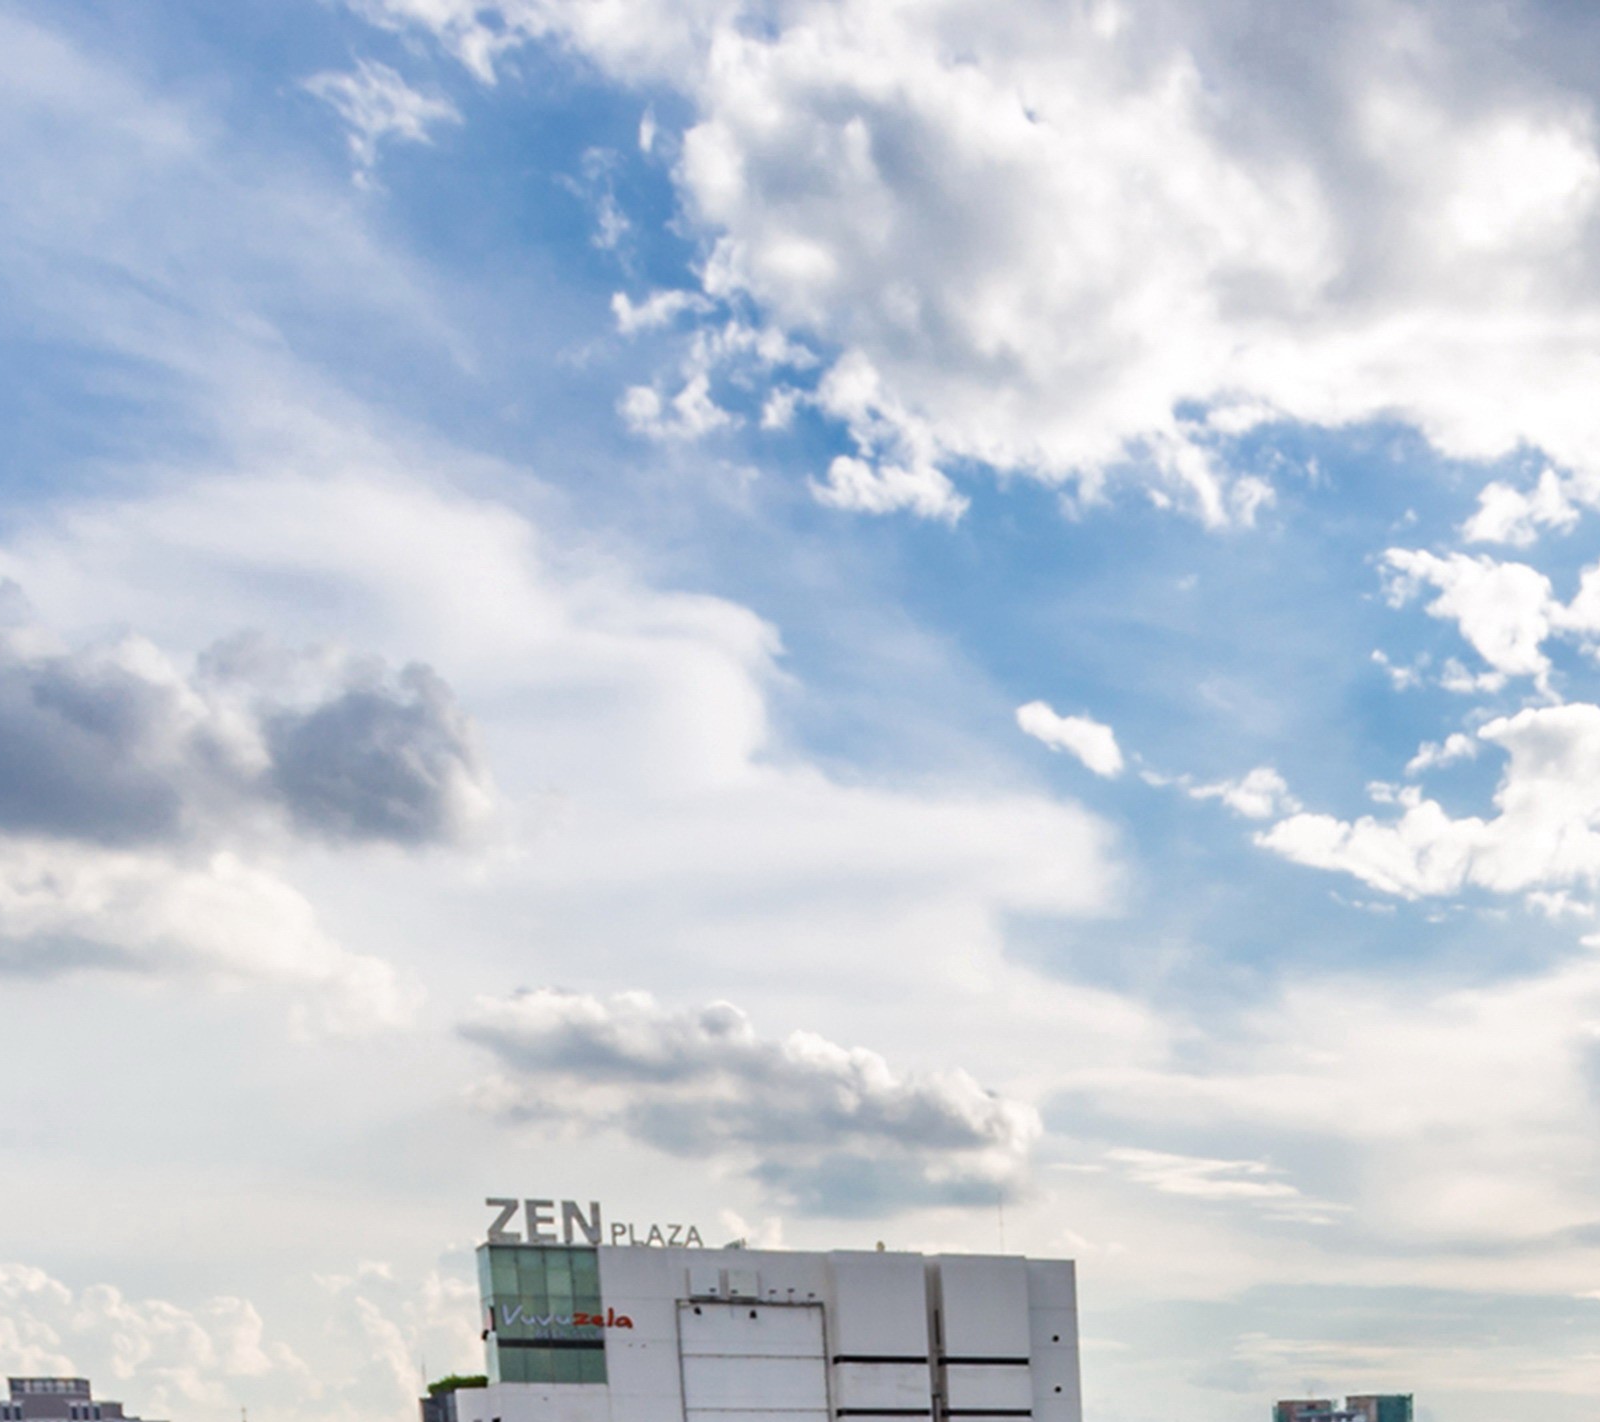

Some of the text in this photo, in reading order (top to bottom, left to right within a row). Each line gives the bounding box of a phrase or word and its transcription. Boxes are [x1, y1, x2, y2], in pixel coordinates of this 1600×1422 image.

[486, 1197, 704, 1248] ZEN PLAZA
[501, 1303, 633, 1329] Vuvuzela
